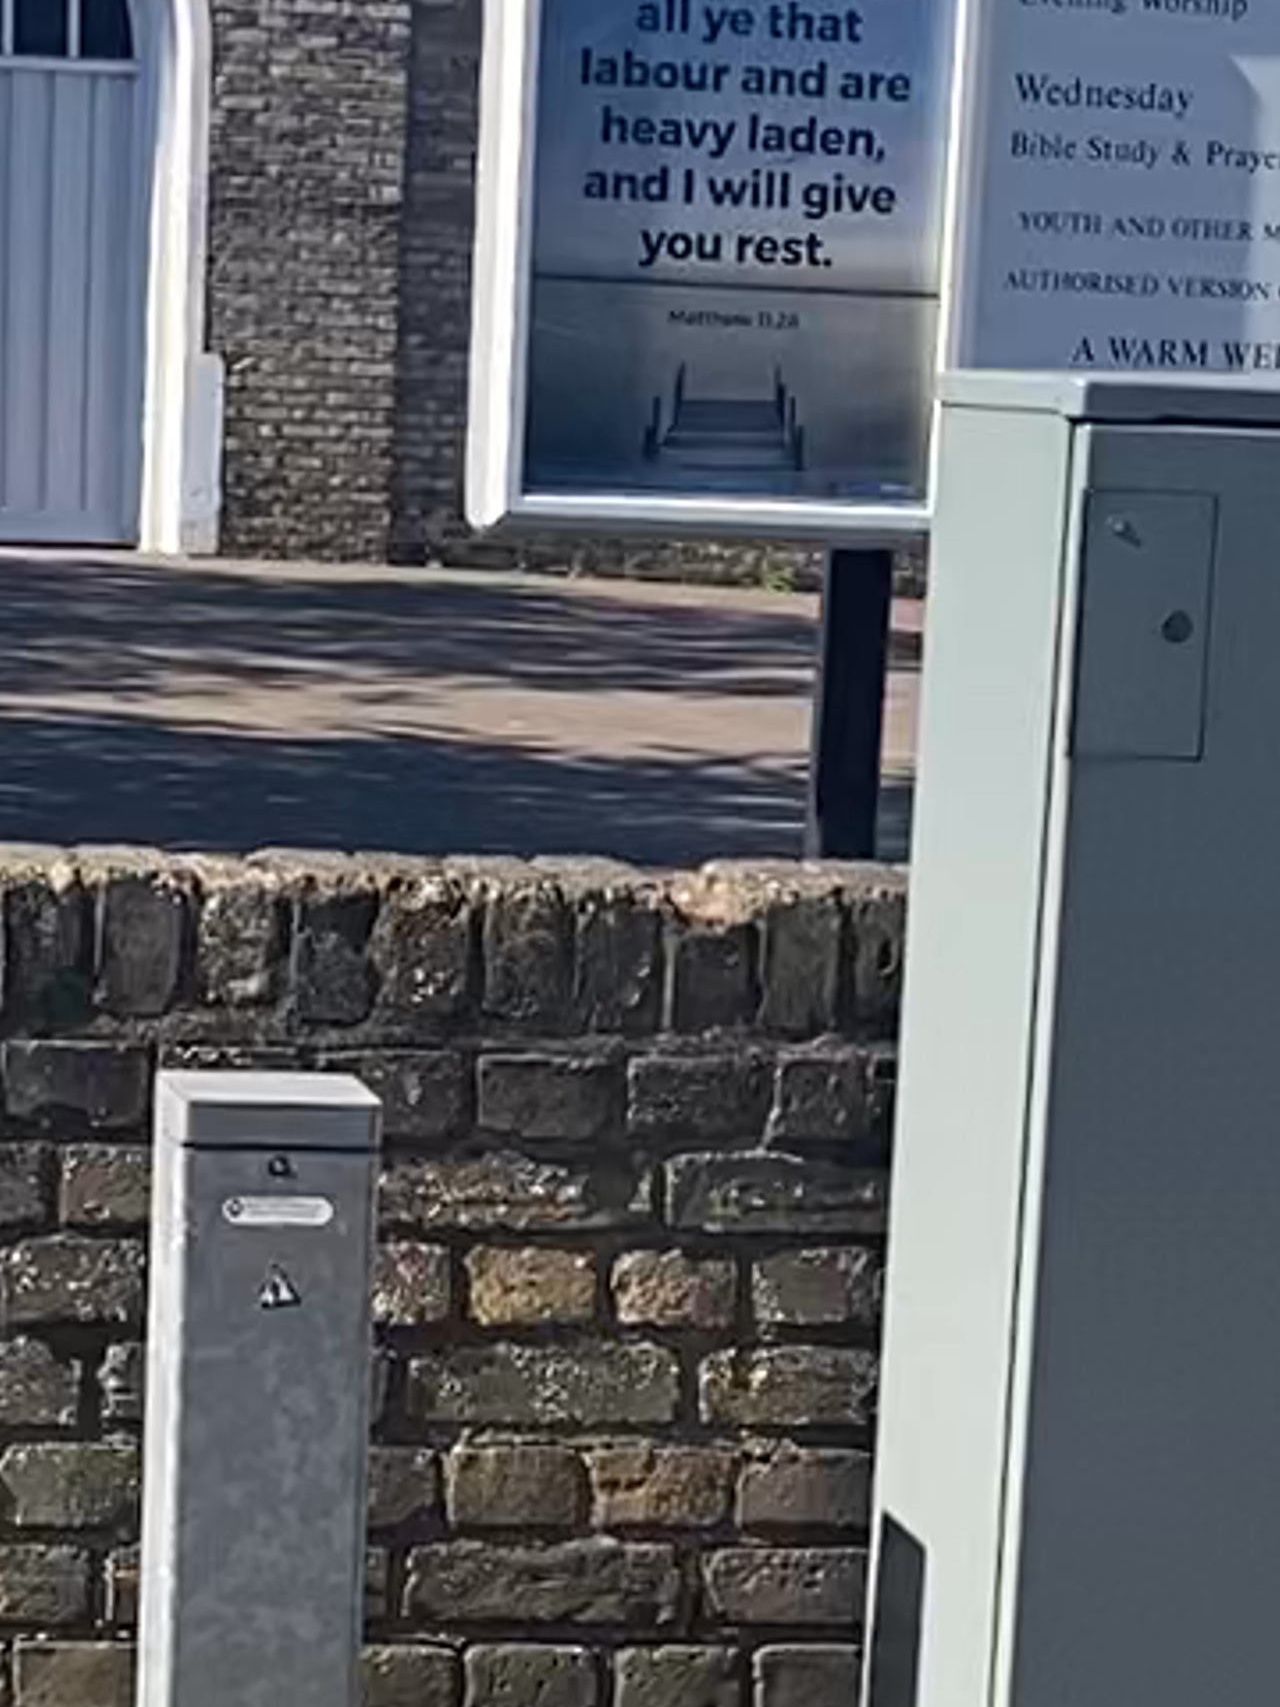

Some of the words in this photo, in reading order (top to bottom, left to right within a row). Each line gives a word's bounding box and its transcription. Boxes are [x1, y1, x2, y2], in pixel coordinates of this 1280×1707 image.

[702, 6, 754, 43] ye
[769, 2, 862, 42] that
[580, 49, 730, 92] labour
[741, 62, 825, 98] and
[840, 72, 910, 102] are
[1016, 73, 1193, 118] Wednesday
[601, 105, 736, 157] heavy
[749, 114, 885, 162] laden,
[1011, 130, 1076, 160] Bible
[1087, 135, 1158, 169] Study
[1172, 141, 1190, 166] &
[584, 167, 668, 202] and
[684, 169, 694, 204] I
[709, 170, 789, 208] will
[802, 174, 896, 219] give
[1018, 211, 1101, 235] YOUTH
[1111, 217, 1164, 239] AND
[1171, 219, 1252, 241] OTHER
[639, 230, 721, 266] you
[737, 232, 832, 267] rest.
[1004, 269, 1159, 296] AUTHORISED
[1168, 277, 1269, 301] VERSION
[1073, 336, 1094, 363] A
[1108, 336, 1208, 367] WARM
